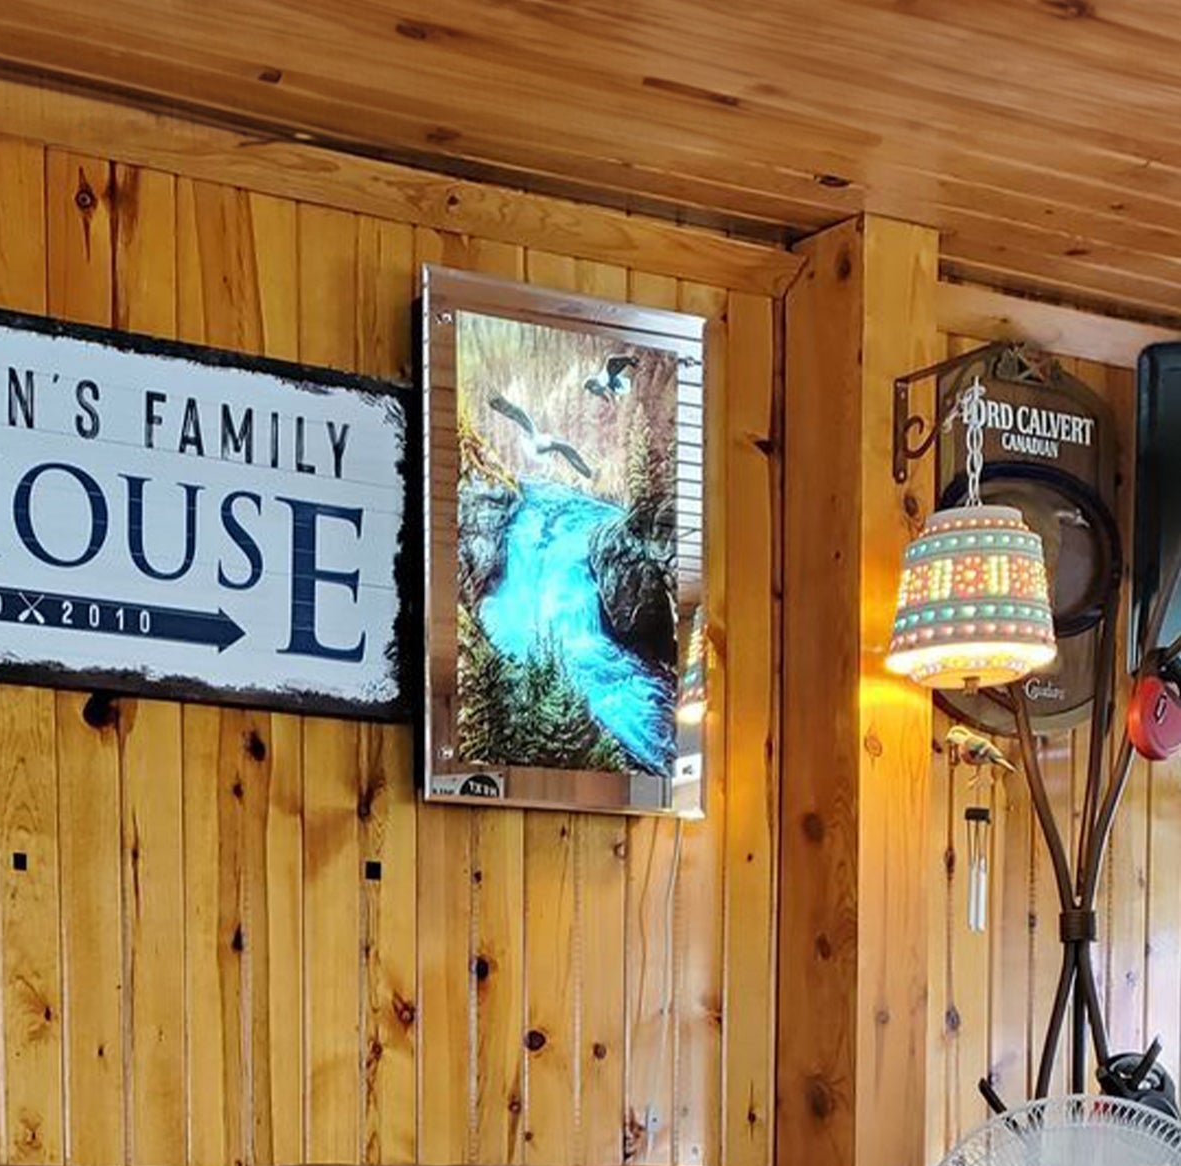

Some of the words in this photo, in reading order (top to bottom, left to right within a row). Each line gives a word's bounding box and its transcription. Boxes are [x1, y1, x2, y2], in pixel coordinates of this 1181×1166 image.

[144, 390, 350, 480] FAMILY
[1017, 405, 1094, 446] CALVERT
[1002, 431, 1059, 459] CANADIAN
[61, 601, 151, 634] 2010
